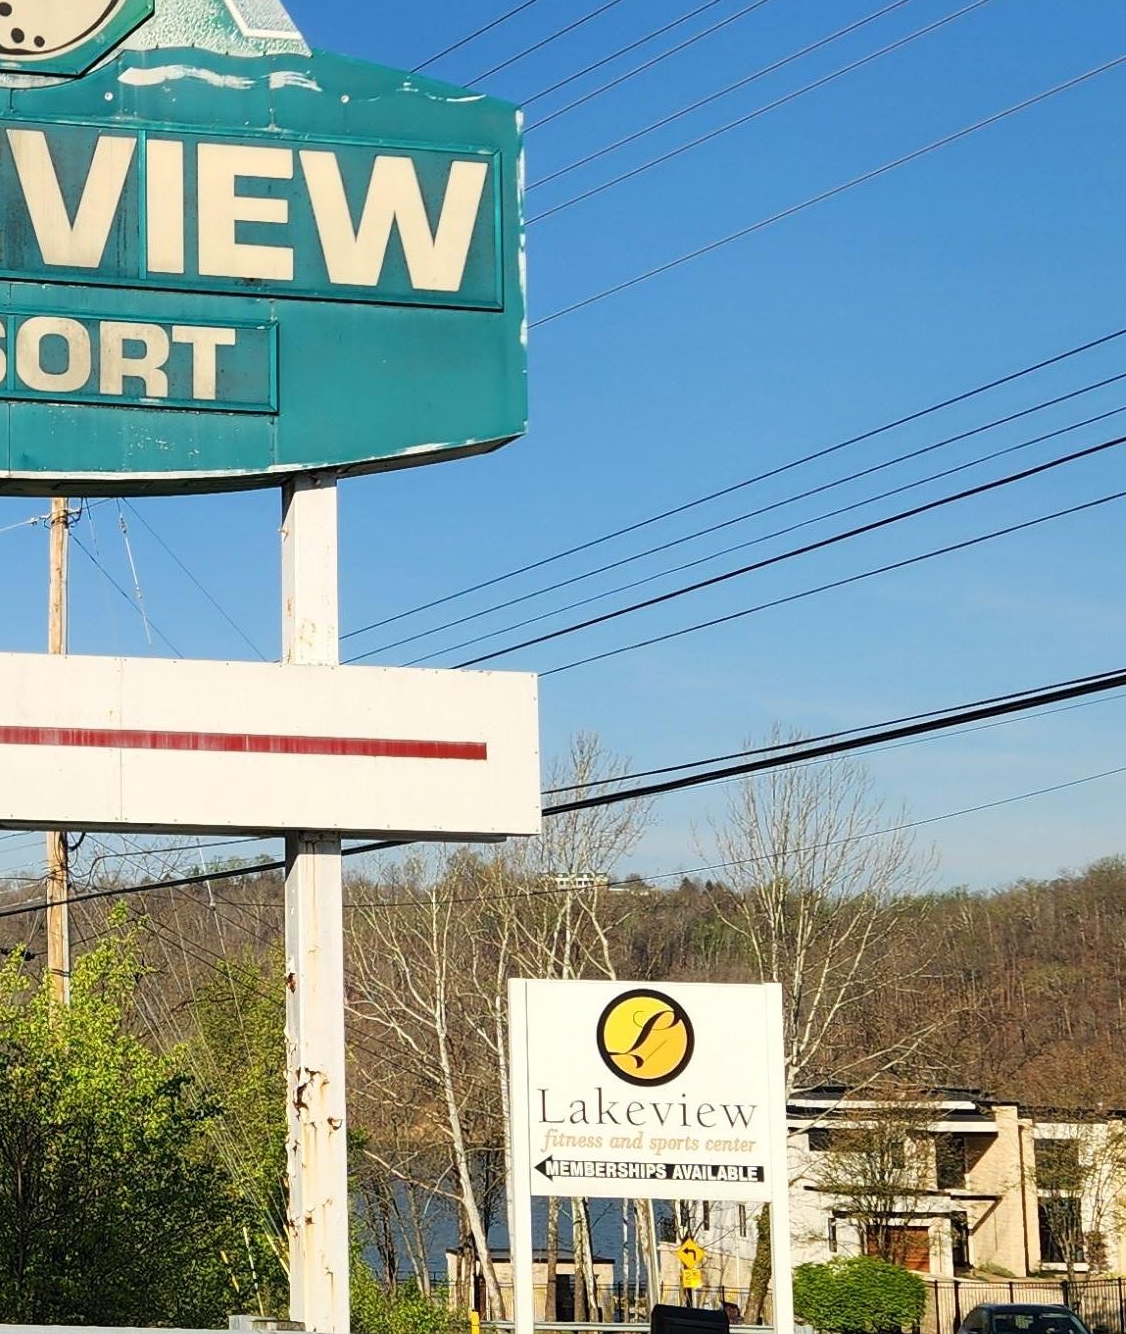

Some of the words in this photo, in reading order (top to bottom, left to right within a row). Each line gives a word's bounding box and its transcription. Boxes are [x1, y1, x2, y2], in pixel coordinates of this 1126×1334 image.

[536, 1087, 758, 1129] Lakeview
[541, 1128, 603, 1153] fitness
[609, 1131, 643, 1150] and
[649, 1135, 699, 1156] sports
[705, 1137, 756, 1153] center
[545, 1160, 667, 1180] MEMBERSHIPS
[672, 1164, 759, 1182] AVAILABLE
